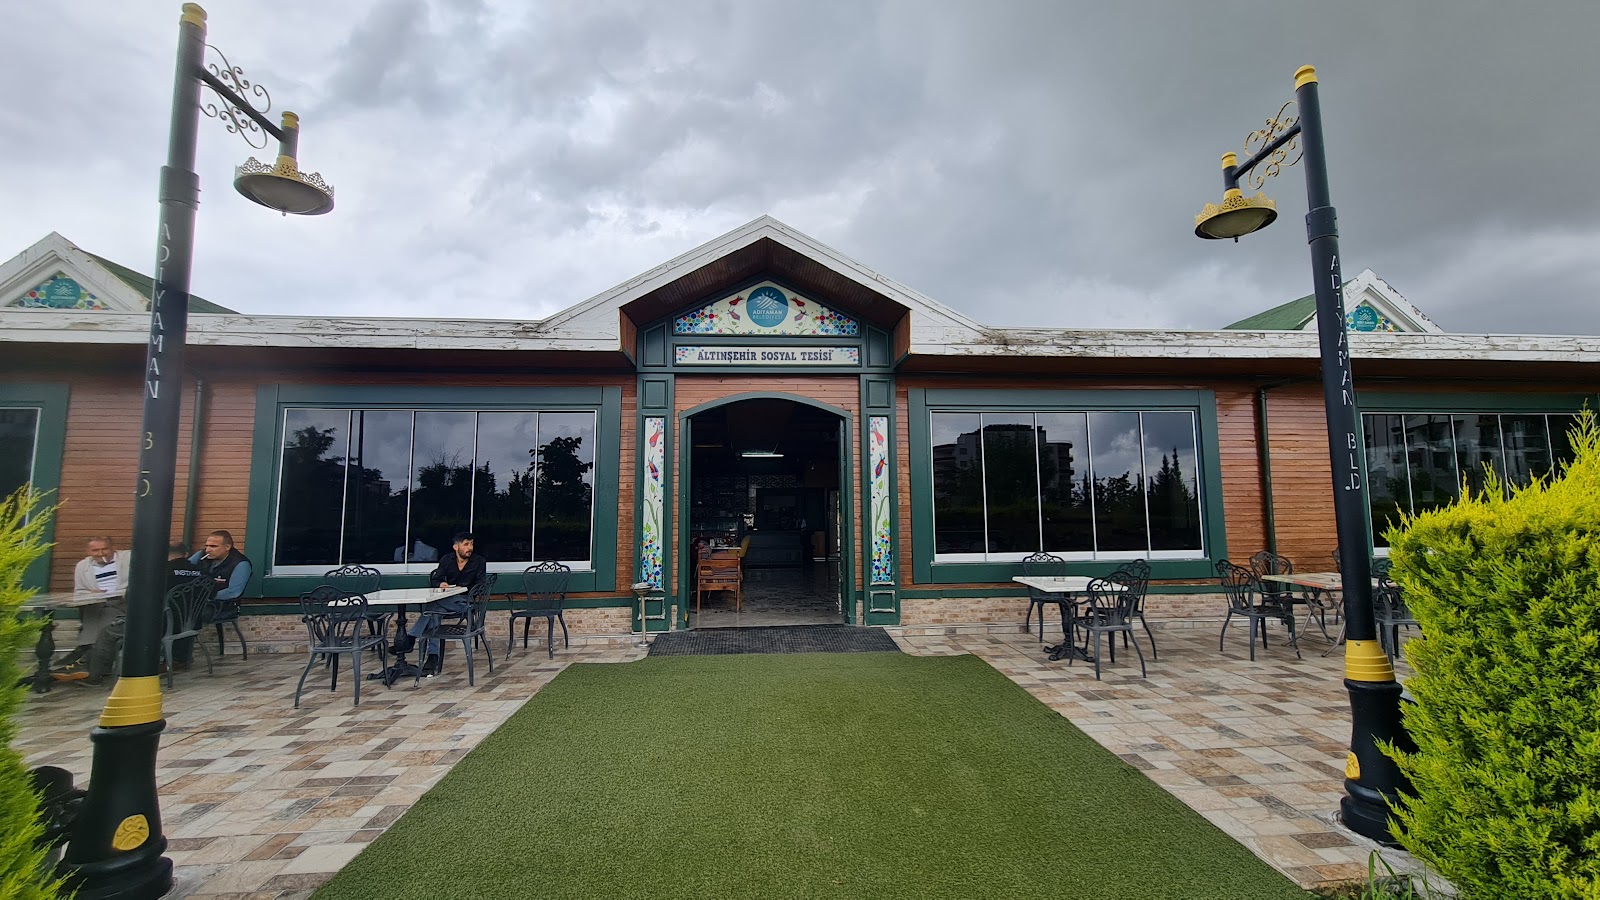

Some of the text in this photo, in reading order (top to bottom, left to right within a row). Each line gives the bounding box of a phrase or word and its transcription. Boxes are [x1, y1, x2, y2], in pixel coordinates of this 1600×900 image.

[147, 223, 171, 399] ADIYAMAN
[697, 349, 833, 363] ALTINŞEHİR SOSYAL TESİSİ
[1330, 255, 1353, 406] ADIYAMAN
